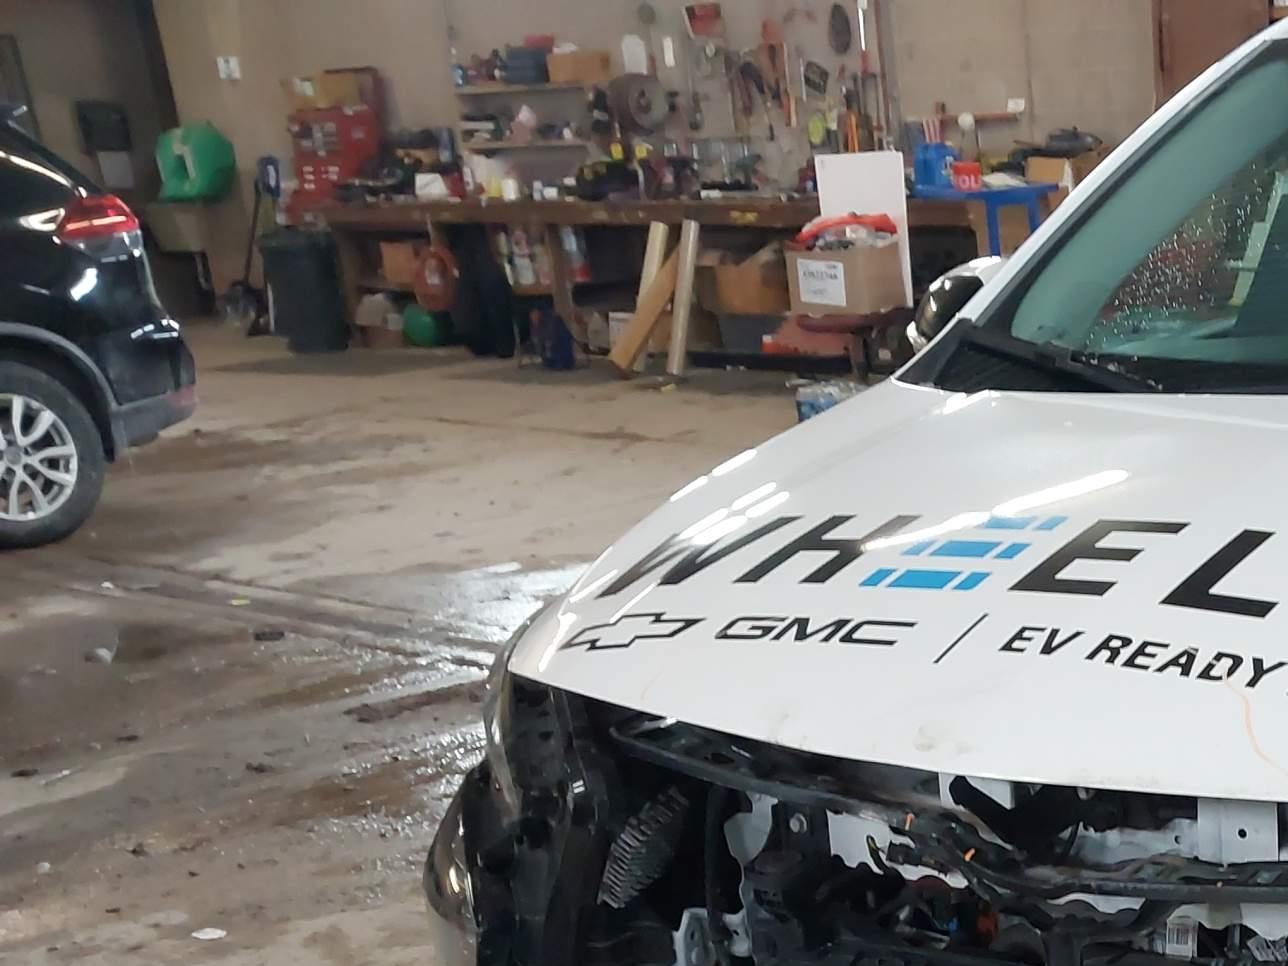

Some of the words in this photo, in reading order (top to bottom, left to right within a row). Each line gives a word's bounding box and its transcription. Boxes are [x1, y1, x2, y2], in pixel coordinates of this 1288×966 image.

[714, 615, 918, 647] GMC
[1000, 626, 1084, 655] EV
[1085, 634, 1288, 689] READY
